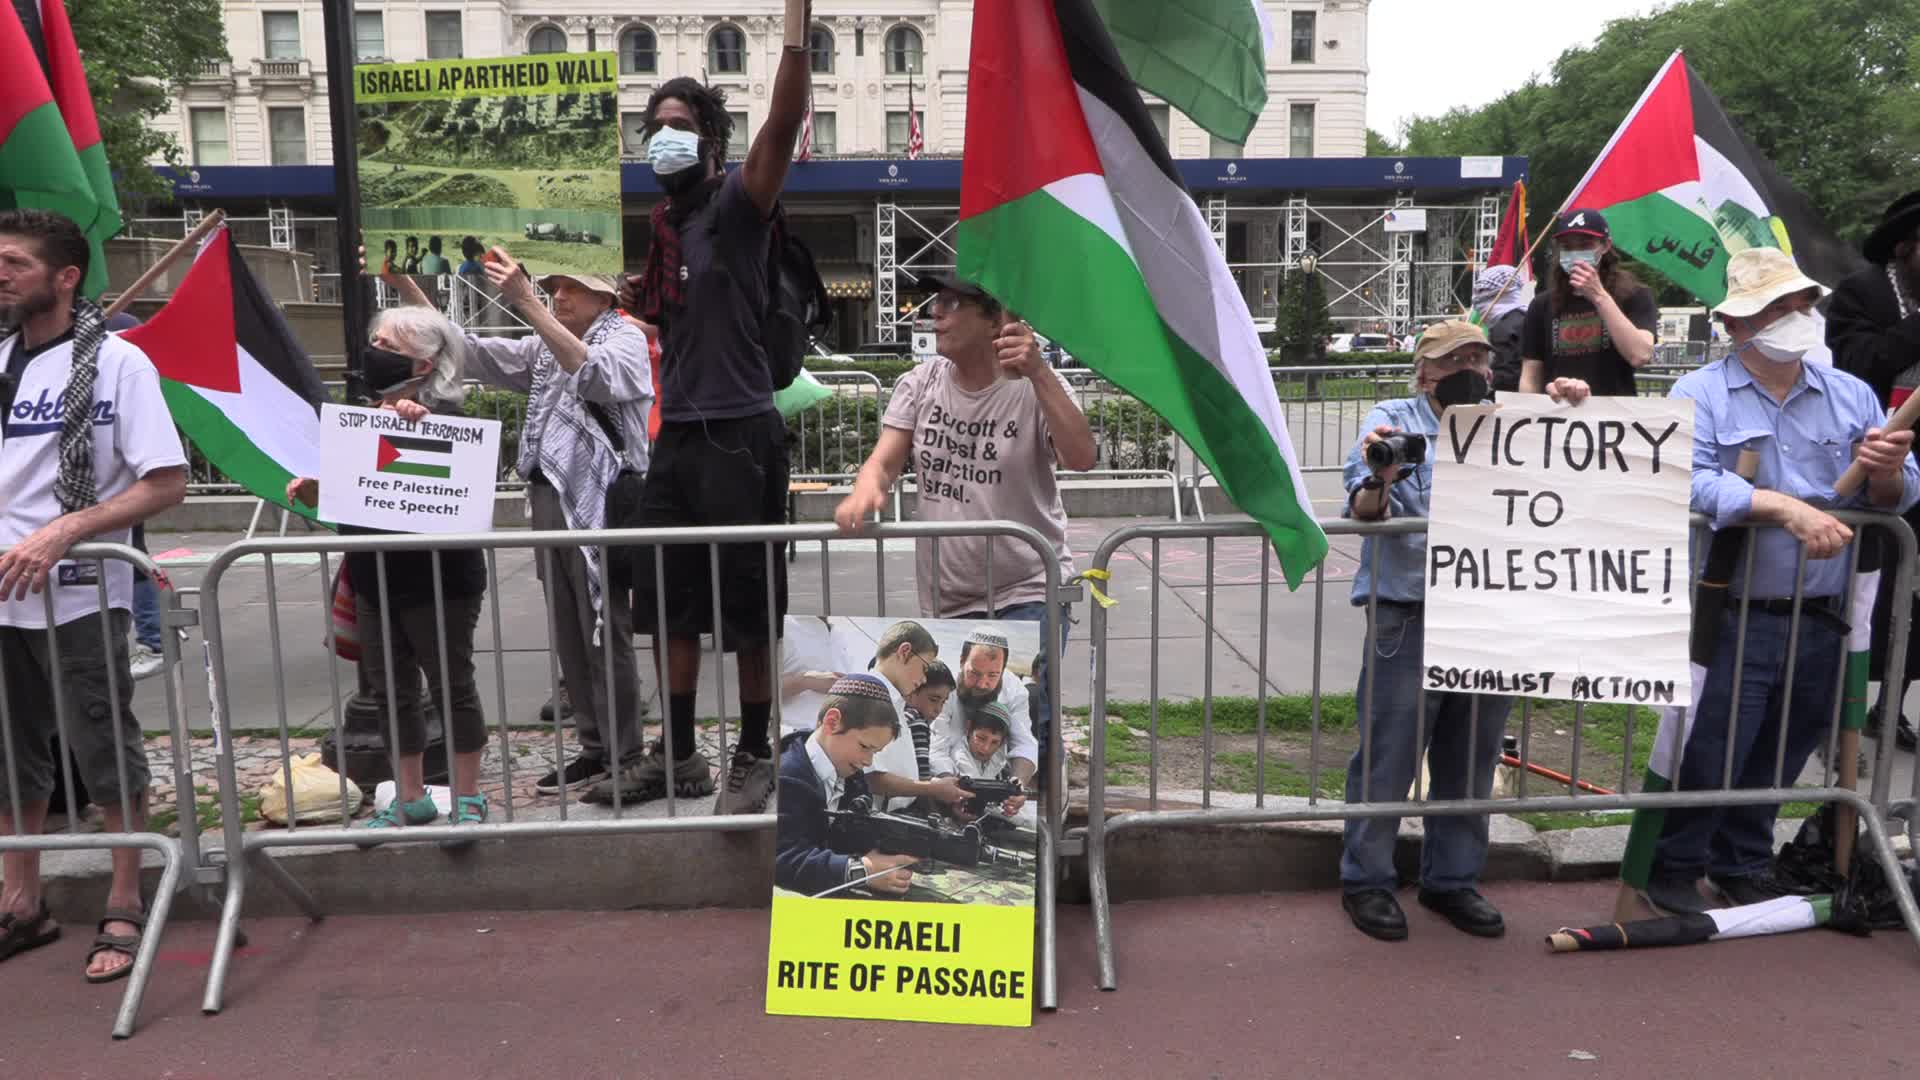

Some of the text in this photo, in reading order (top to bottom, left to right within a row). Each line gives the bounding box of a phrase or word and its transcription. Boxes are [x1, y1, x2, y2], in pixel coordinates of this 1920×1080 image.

[360, 59, 613, 94] ISRAELI APARTHEID WALL
[339, 412, 484, 444] STOP ISRAELI TERRORISM
[1003, 420, 1018, 438] &
[1449, 414, 1680, 474] VICTORY
[982, 442, 998, 461] &
[358, 477, 469, 498] Free Palestine!
[365, 496, 459, 515] Free Speech!
[1492, 489, 1564, 527] TO
[1430, 545, 1673, 605] PALESTINE!
[1427, 665, 1675, 703] SOCIALIST ACTION
[844, 918, 961, 953] ISRAELI
[777, 960, 1025, 999] RITE OF PASSAGE
